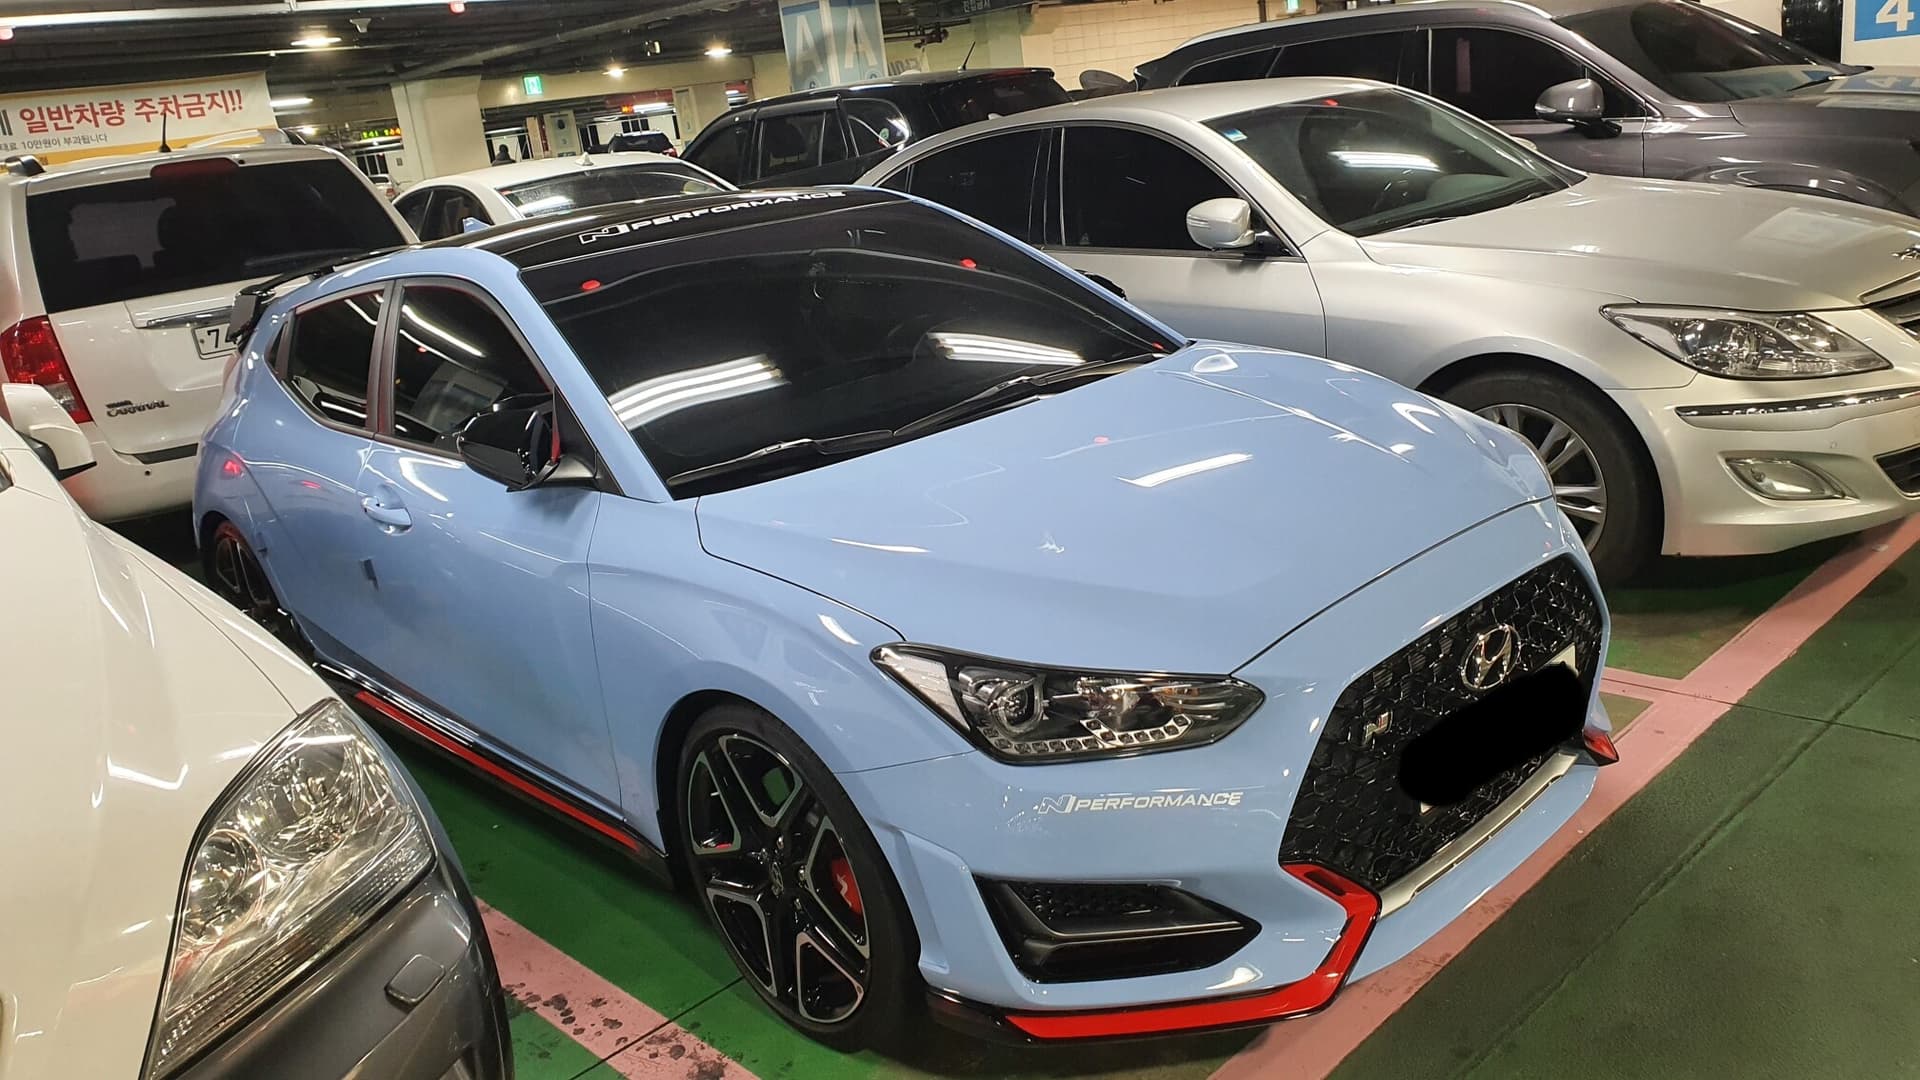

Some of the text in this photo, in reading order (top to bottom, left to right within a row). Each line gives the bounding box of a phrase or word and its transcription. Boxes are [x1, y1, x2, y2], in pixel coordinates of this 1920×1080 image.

[844, 8, 878, 69] A
[20, 100, 125, 134] 일반차량
[134, 89, 243, 123] 주차금지!!
[21, 138, 60, 149] 10만원이
[63, 134, 107, 146] 부과됩니다
[631, 191, 847, 230] PERFORMANCE
[1074, 792, 1244, 812] PERFORMANCE
